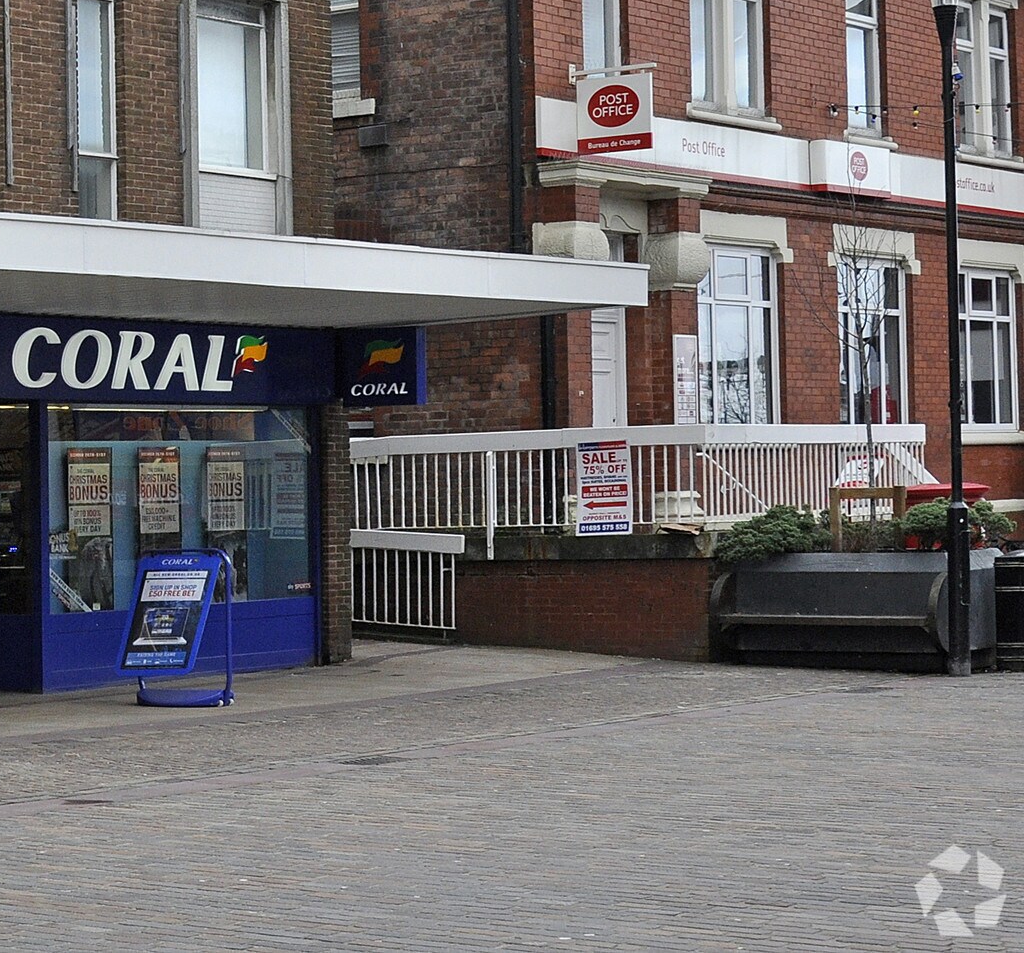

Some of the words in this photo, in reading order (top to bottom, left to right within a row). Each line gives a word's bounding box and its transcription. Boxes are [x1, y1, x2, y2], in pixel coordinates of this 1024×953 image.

[600, 92, 629, 105] POST
[592, 104, 633, 118] OFFICE
[682, 138, 700, 154] Post
[703, 141, 726, 158] Office
[854, 156, 865, 165] POST
[852, 165, 866, 174] OFFICE
[957, 178, 995, 192] stoffice.co.uk
[11, 326, 234, 392] CORAL
[350, 382, 408, 397] CORAL
[582, 452, 616, 464] SALE
[584, 466, 604, 475] 75%
[608, 464, 626, 473] OFF
[70, 475, 107, 484] CHRISTMAS
[140, 474, 176, 483] CHRISTMAS
[209, 472, 241, 481] CHRISTMAS
[70, 485, 108, 500] BONUS
[140, 484, 177, 499] BONUS
[209, 482, 242, 497] BONUS
[49, 533, 69, 545] ONUS
[162, 558, 194, 566] CORAL
